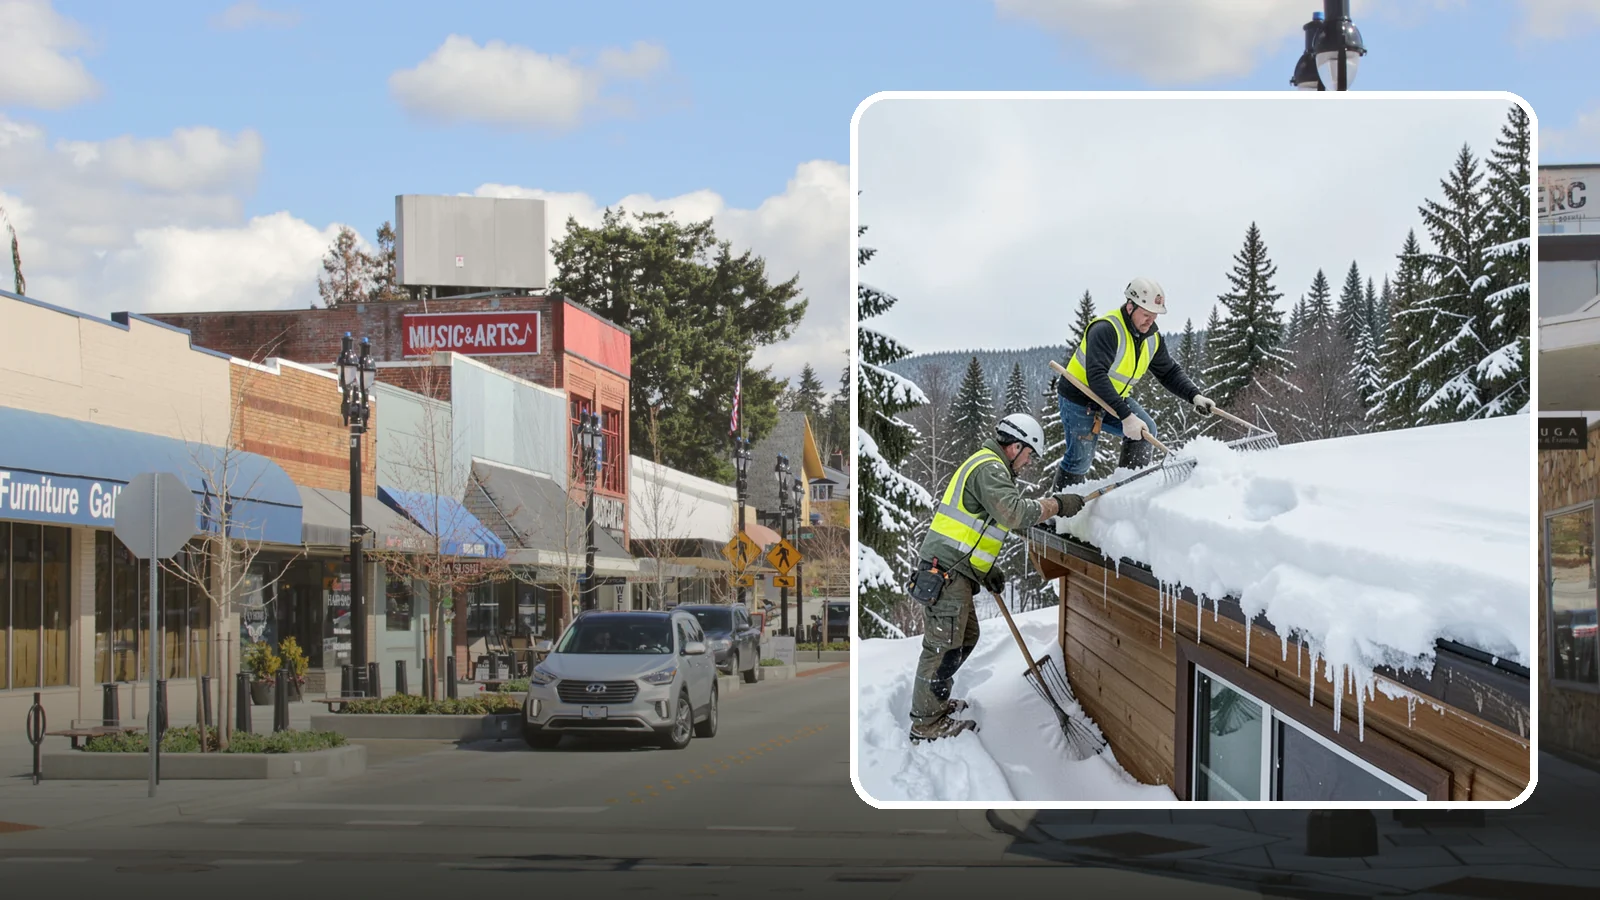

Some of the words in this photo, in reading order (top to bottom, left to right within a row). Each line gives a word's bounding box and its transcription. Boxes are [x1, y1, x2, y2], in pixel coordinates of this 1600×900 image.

[0, 471, 79, 515] Furniture
[89, 482, 122, 519] Gal
[453, 563, 479, 575] SUSHI
